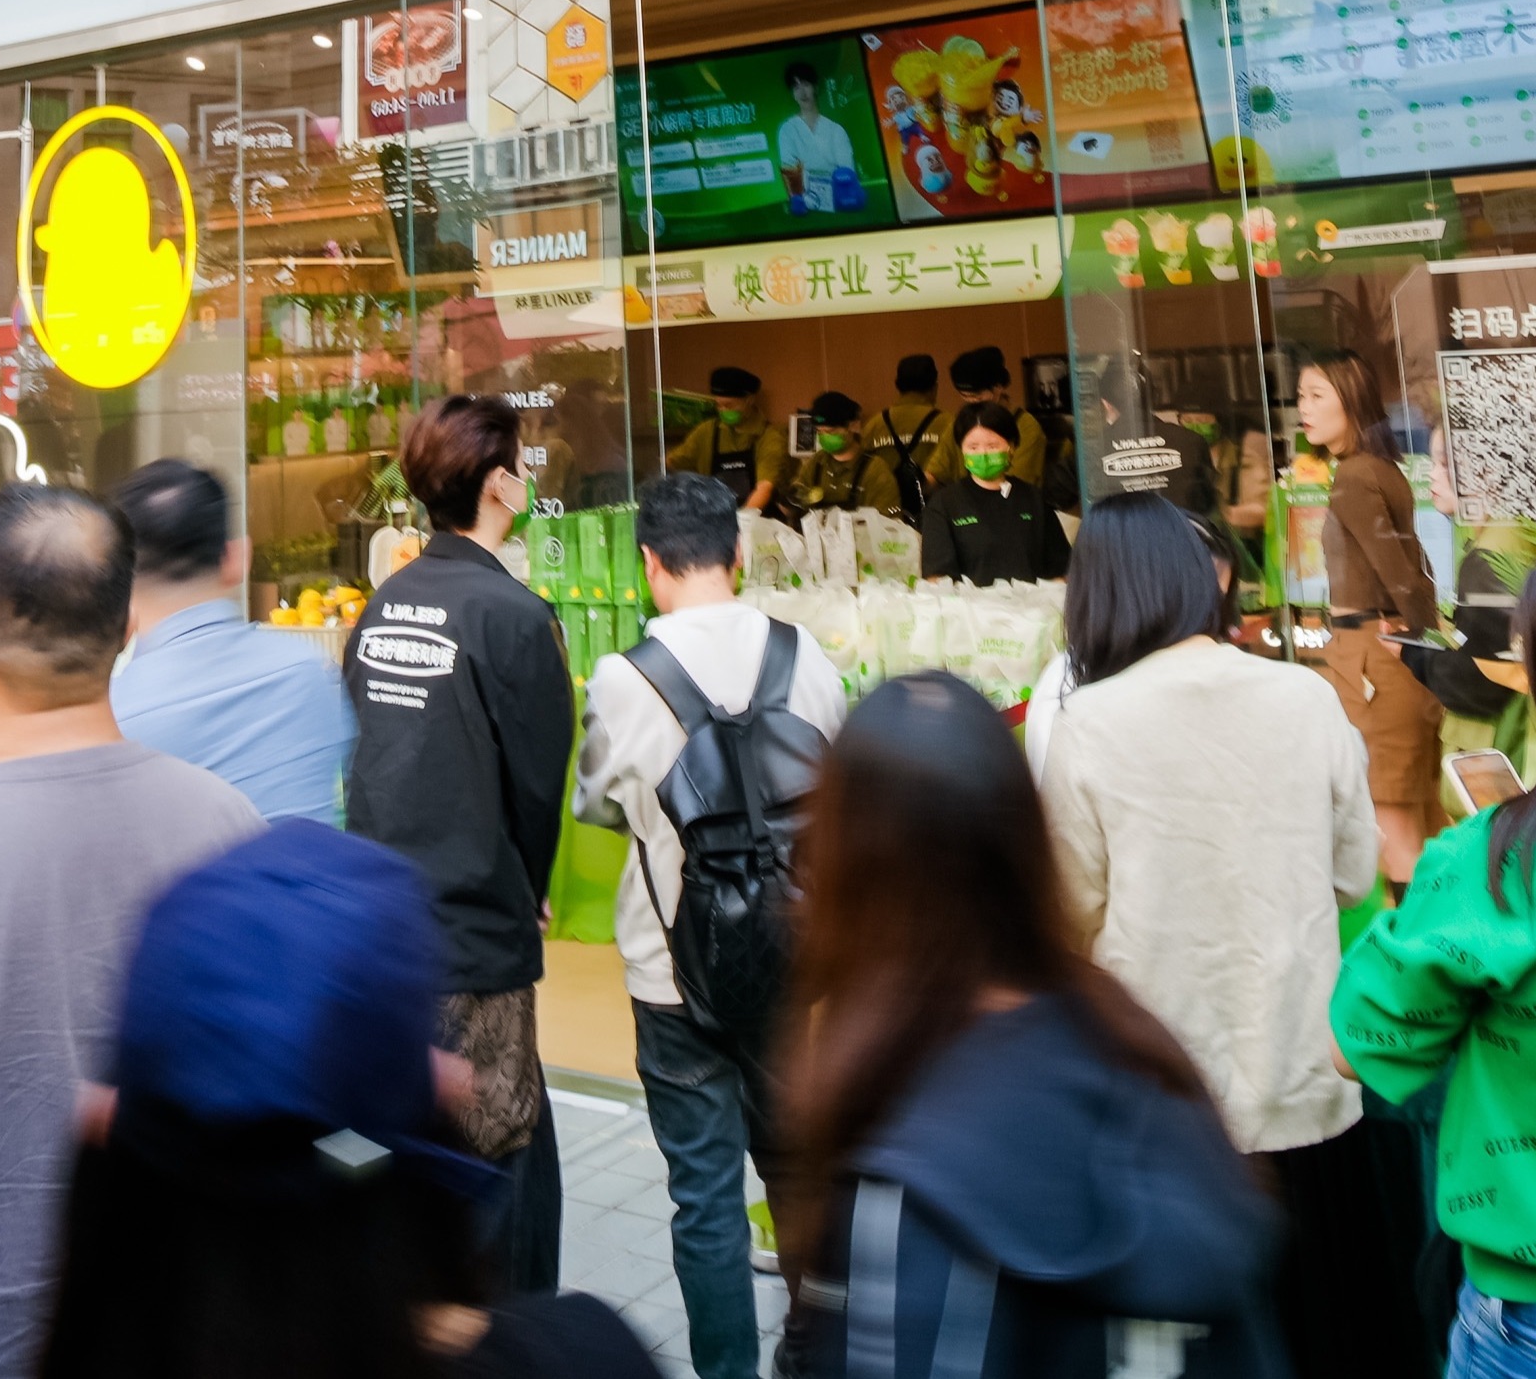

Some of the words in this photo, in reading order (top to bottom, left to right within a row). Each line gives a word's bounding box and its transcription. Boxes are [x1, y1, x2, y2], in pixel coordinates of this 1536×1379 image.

[733, 254, 872, 305] 焕新开业
[886, 242, 1041, 294] 买一送一!
